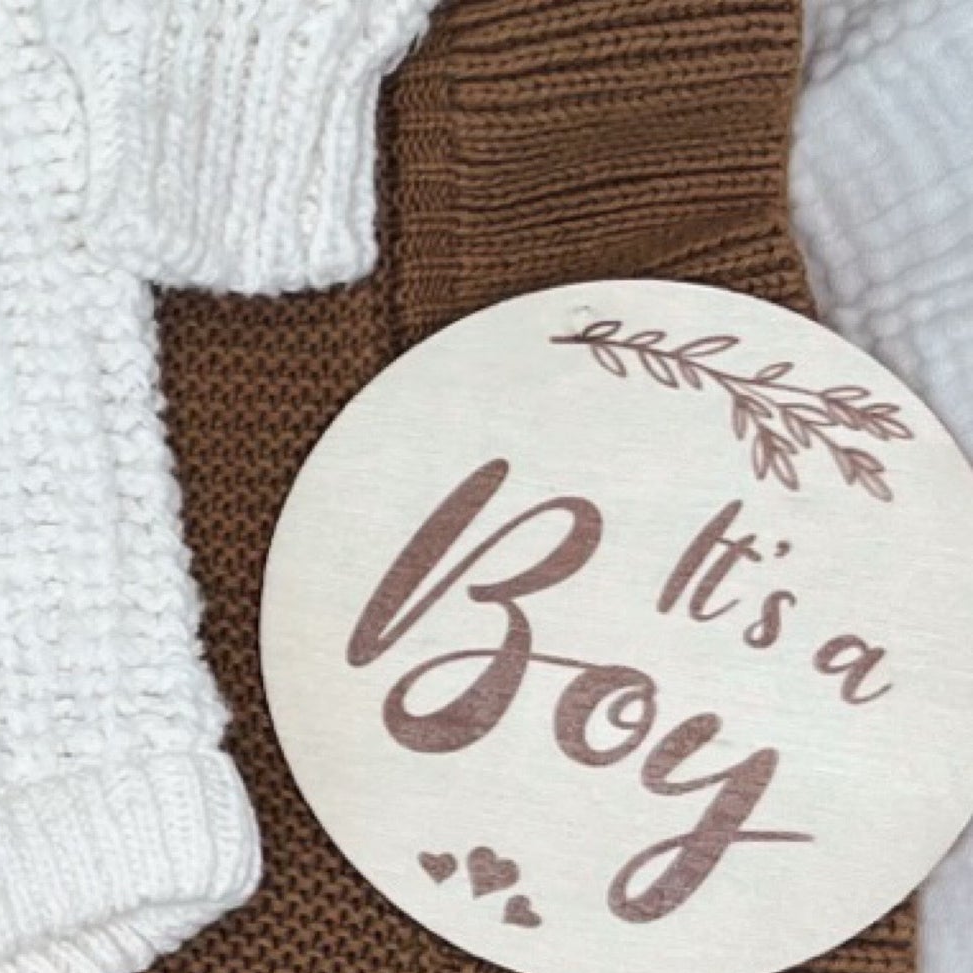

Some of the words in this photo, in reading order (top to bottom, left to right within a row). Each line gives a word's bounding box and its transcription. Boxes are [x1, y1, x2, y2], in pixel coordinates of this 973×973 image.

[346, 458, 815, 923] Boy
[657, 500, 796, 649] It's
[814, 634, 892, 706] a
